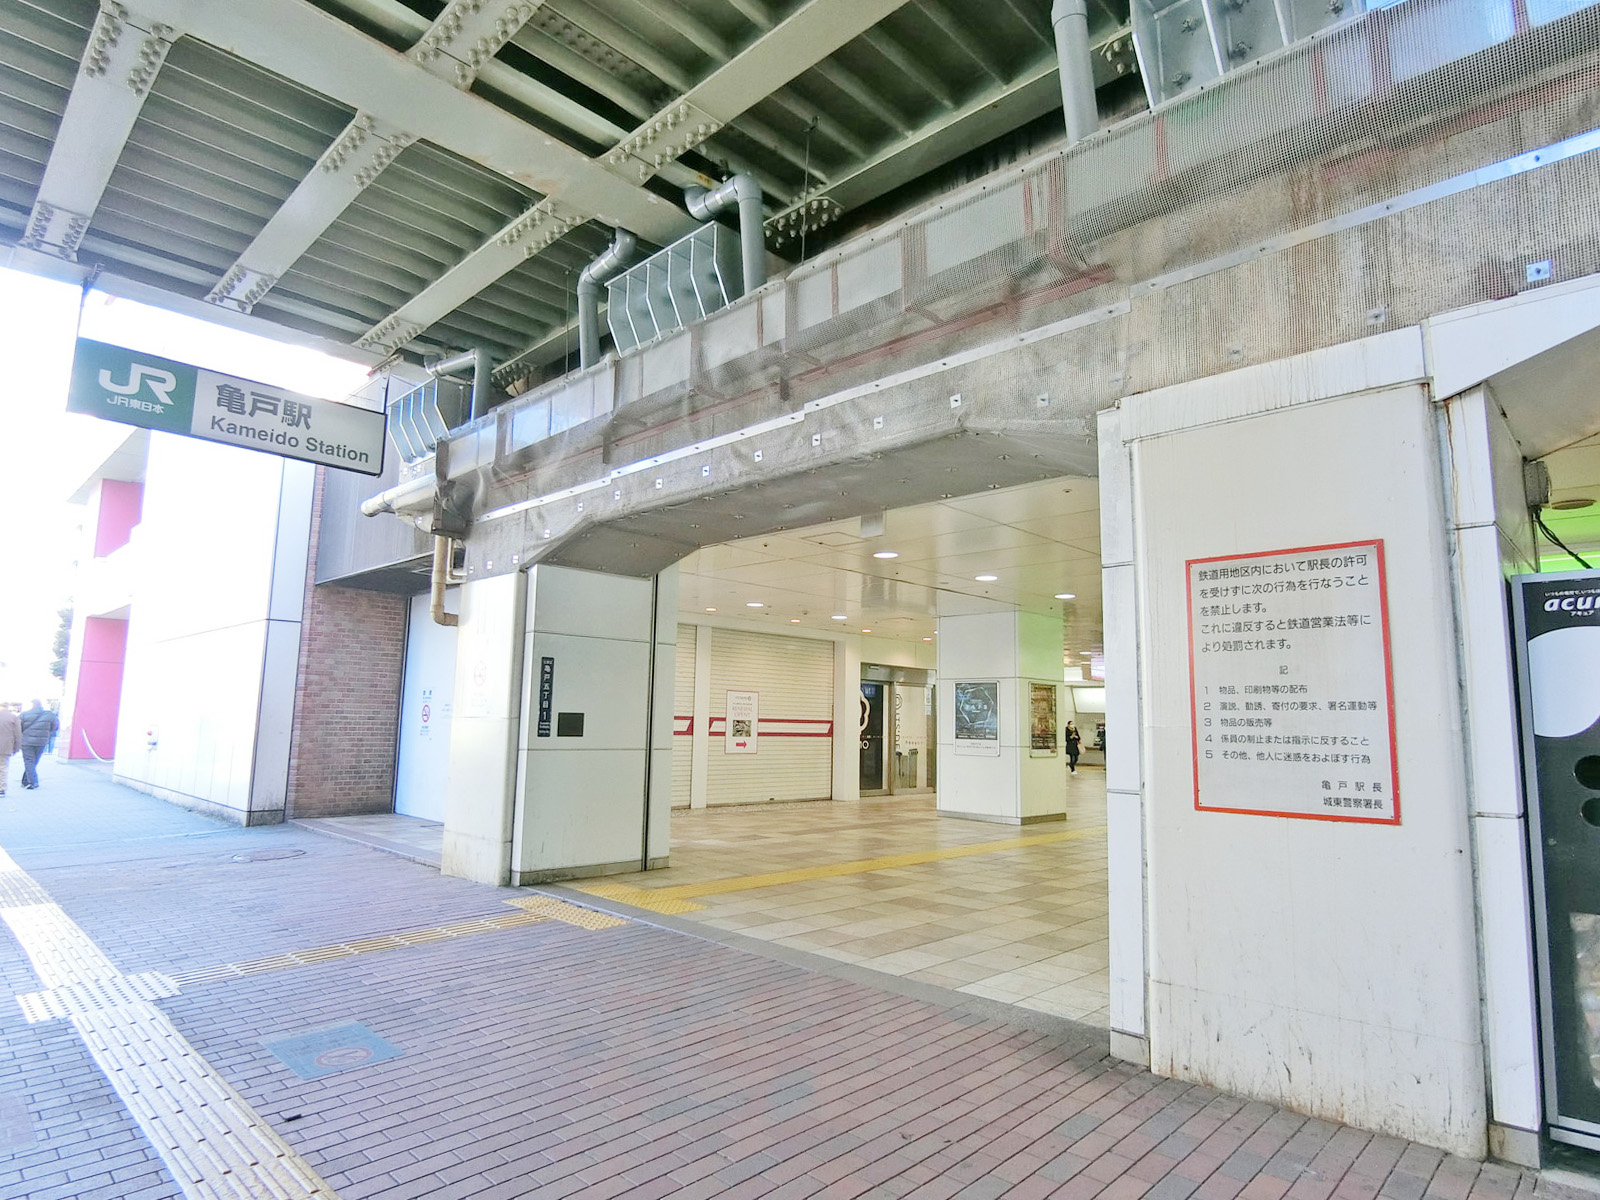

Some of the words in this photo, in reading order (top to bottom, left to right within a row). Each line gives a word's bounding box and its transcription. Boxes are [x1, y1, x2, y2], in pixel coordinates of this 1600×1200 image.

[99, 362, 177, 406] JR
[106, 394, 165, 415] JR東日本
[215, 383, 313, 430] 亀戸駅
[210, 415, 299, 448] Kameido
[305, 437, 370, 464] Station
[1198, 554, 1368, 582] 鉄道用地区内において駅長の許可
[1199, 574, 1369, 599] を受けずに次の行為を行なうこと
[1200, 601, 1267, 617] を禁止します。
[1201, 614, 1372, 635] これに違反すると鉄道営業法等に
[1201, 638, 1292, 653] より処罰されます。
[1279, 665, 1289, 675] 記
[1204, 686, 1209, 695] 1
[1218, 684, 1308, 695] 物品、印刷物等の配布
[1203, 702, 1211, 711] 2
[1204, 718, 1212, 727] 3
[1220, 718, 1273, 728] 物品の販売等
[1204, 734, 1213, 743] 4
[1220, 734, 1369, 747] 係員の制止または指示に反すること
[1205, 750, 1213, 759] 5
[1221, 750, 1371, 765] その他、他人に迷惑をおよぼす行為
[1322, 797, 1384, 810] 城東警察署長
